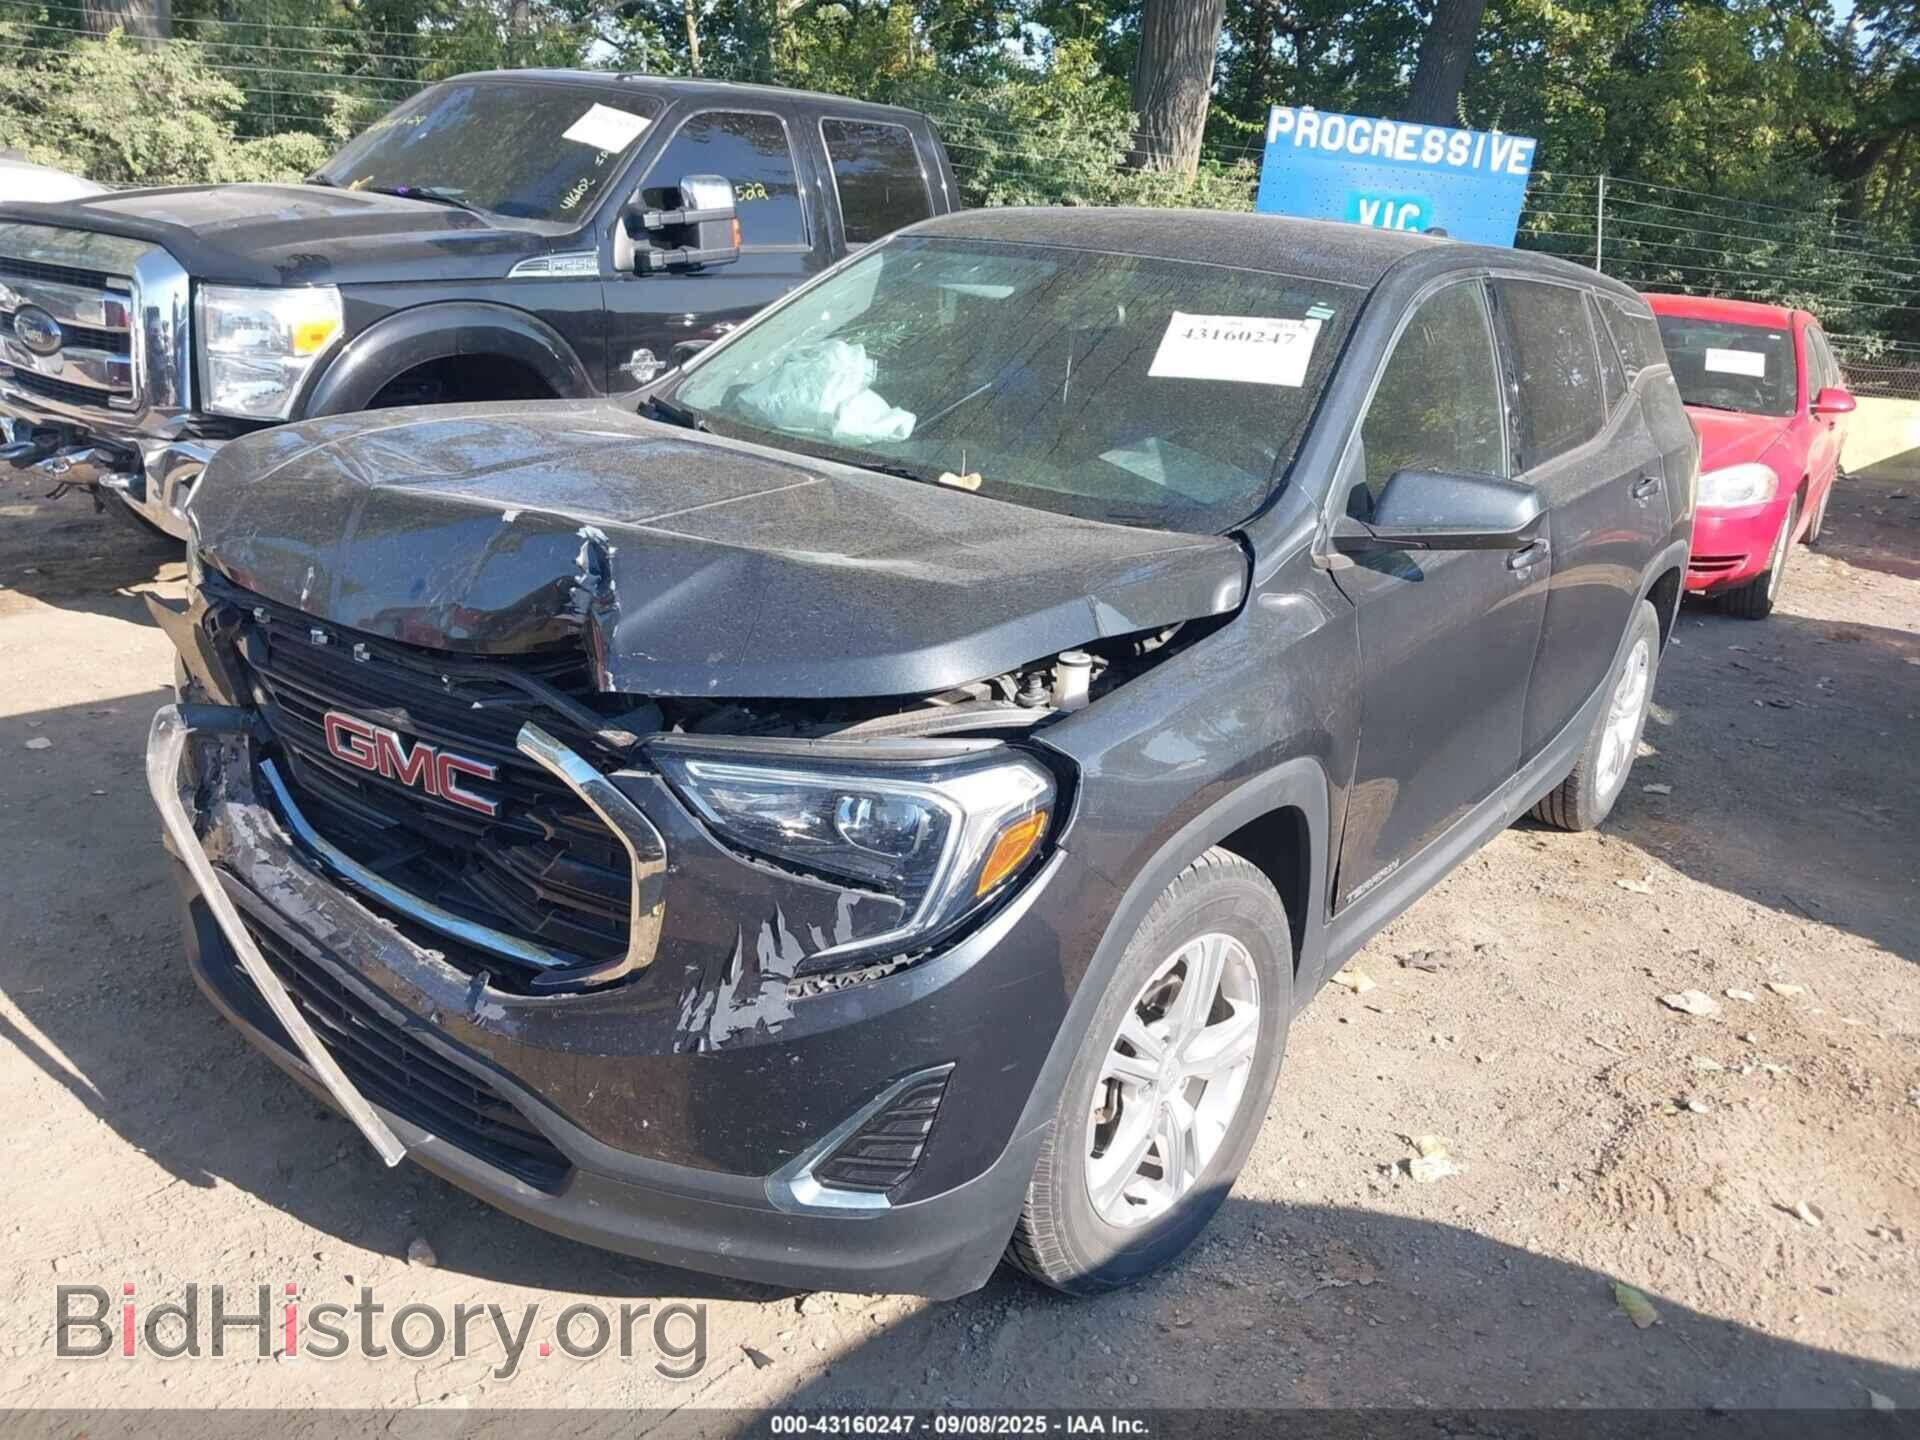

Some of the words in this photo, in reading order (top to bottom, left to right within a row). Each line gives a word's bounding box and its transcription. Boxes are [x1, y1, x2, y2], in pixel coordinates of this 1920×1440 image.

[1268, 108, 1538, 176] PROGRESSIVE
[1181, 327, 1297, 345] 43160247
[324, 710, 498, 817] GMC
